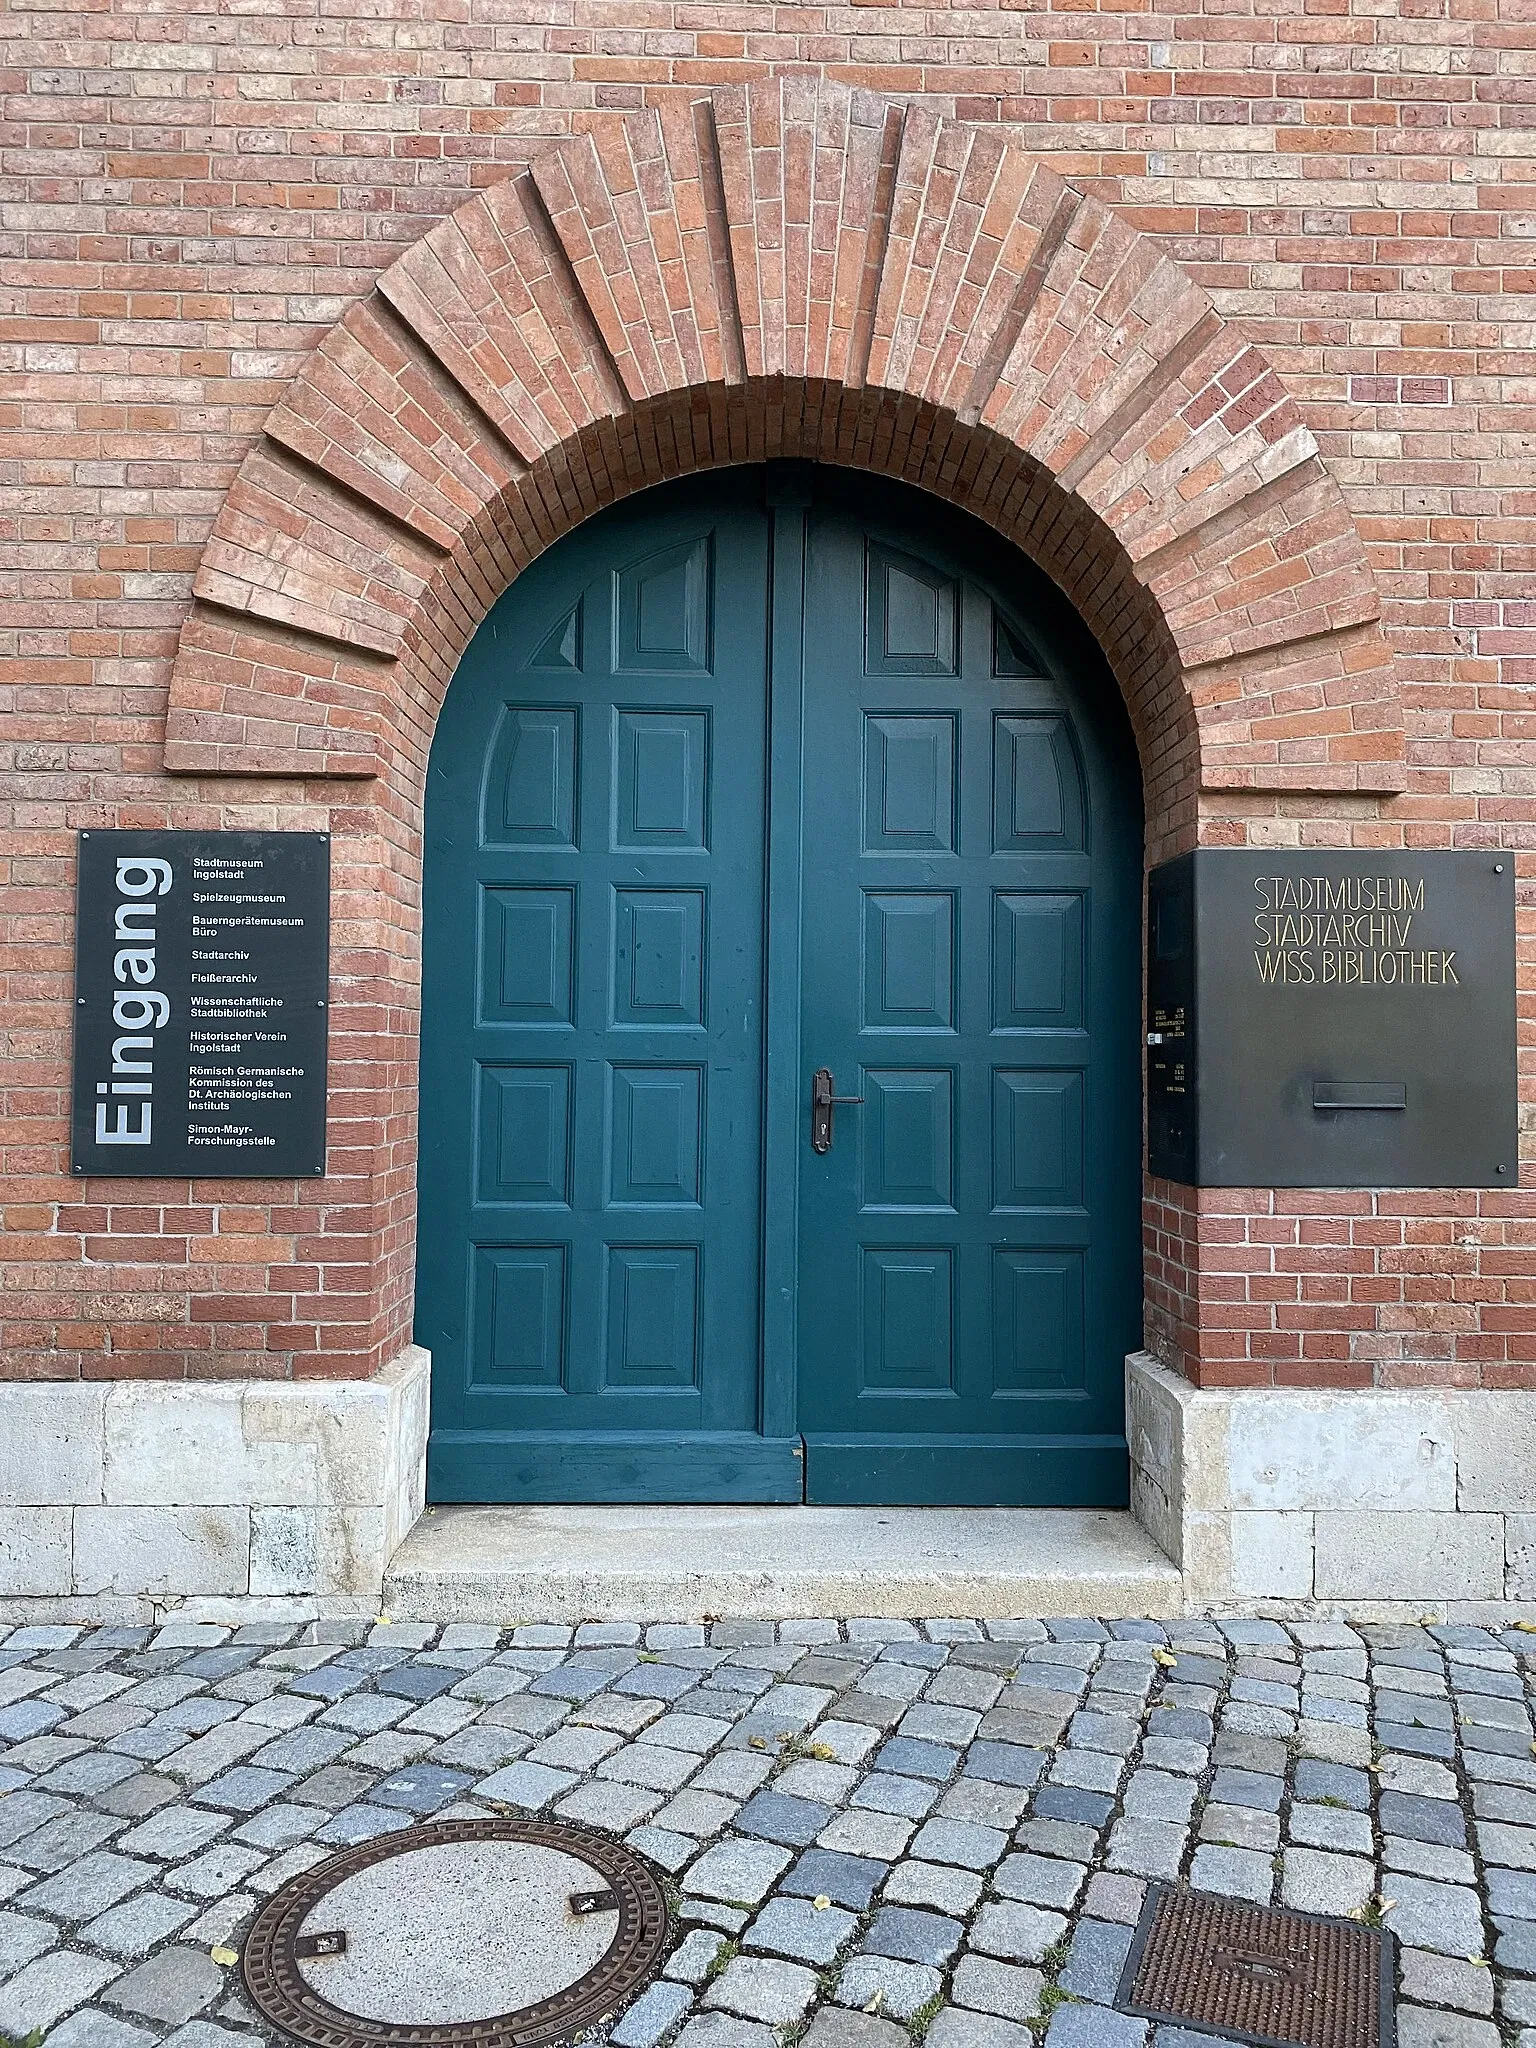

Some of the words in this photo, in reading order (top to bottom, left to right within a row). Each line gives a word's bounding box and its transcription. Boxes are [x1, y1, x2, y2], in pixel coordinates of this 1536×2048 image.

[193, 857, 264, 869] Stadtmuseum
[193, 869, 245, 880] Ingolstadt
[192, 892, 286, 903] Spielzeugmuseum
[1253, 877, 1425, 911] STADTMUSEUM
[192, 915, 304, 927] Bauerngerätemuseum
[192, 926, 218, 937] Büro
[1253, 913, 1413, 948] STADTARCHIV
[191, 950, 250, 960] Stadtarchiv
[191, 973, 258, 983] Fleißerarchiv
[95, 856, 173, 1145] Eingang
[190, 996, 284, 1007] Wissenschaftliche
[190, 1008, 268, 1018] Stadtbibliothek
[190, 1031, 253, 1041] Historischer
[254, 1031, 287, 1041] Verein
[189, 1042, 241, 1053] Ingolstadt
[189, 1065, 235, 1076] Römisch
[236, 1066, 305, 1076] Germanische
[189, 1077, 253, 1088] Kommission
[255, 1078, 274, 1088] des
[188, 1089, 204, 1099] Dt.
[205, 1089, 292, 1101] Archäologischen
[188, 1101, 230, 1111] Instituts
[187, 1124, 253, 1135] Simon-Mayr-
[187, 1136, 276, 1147] Forschungsstelle
